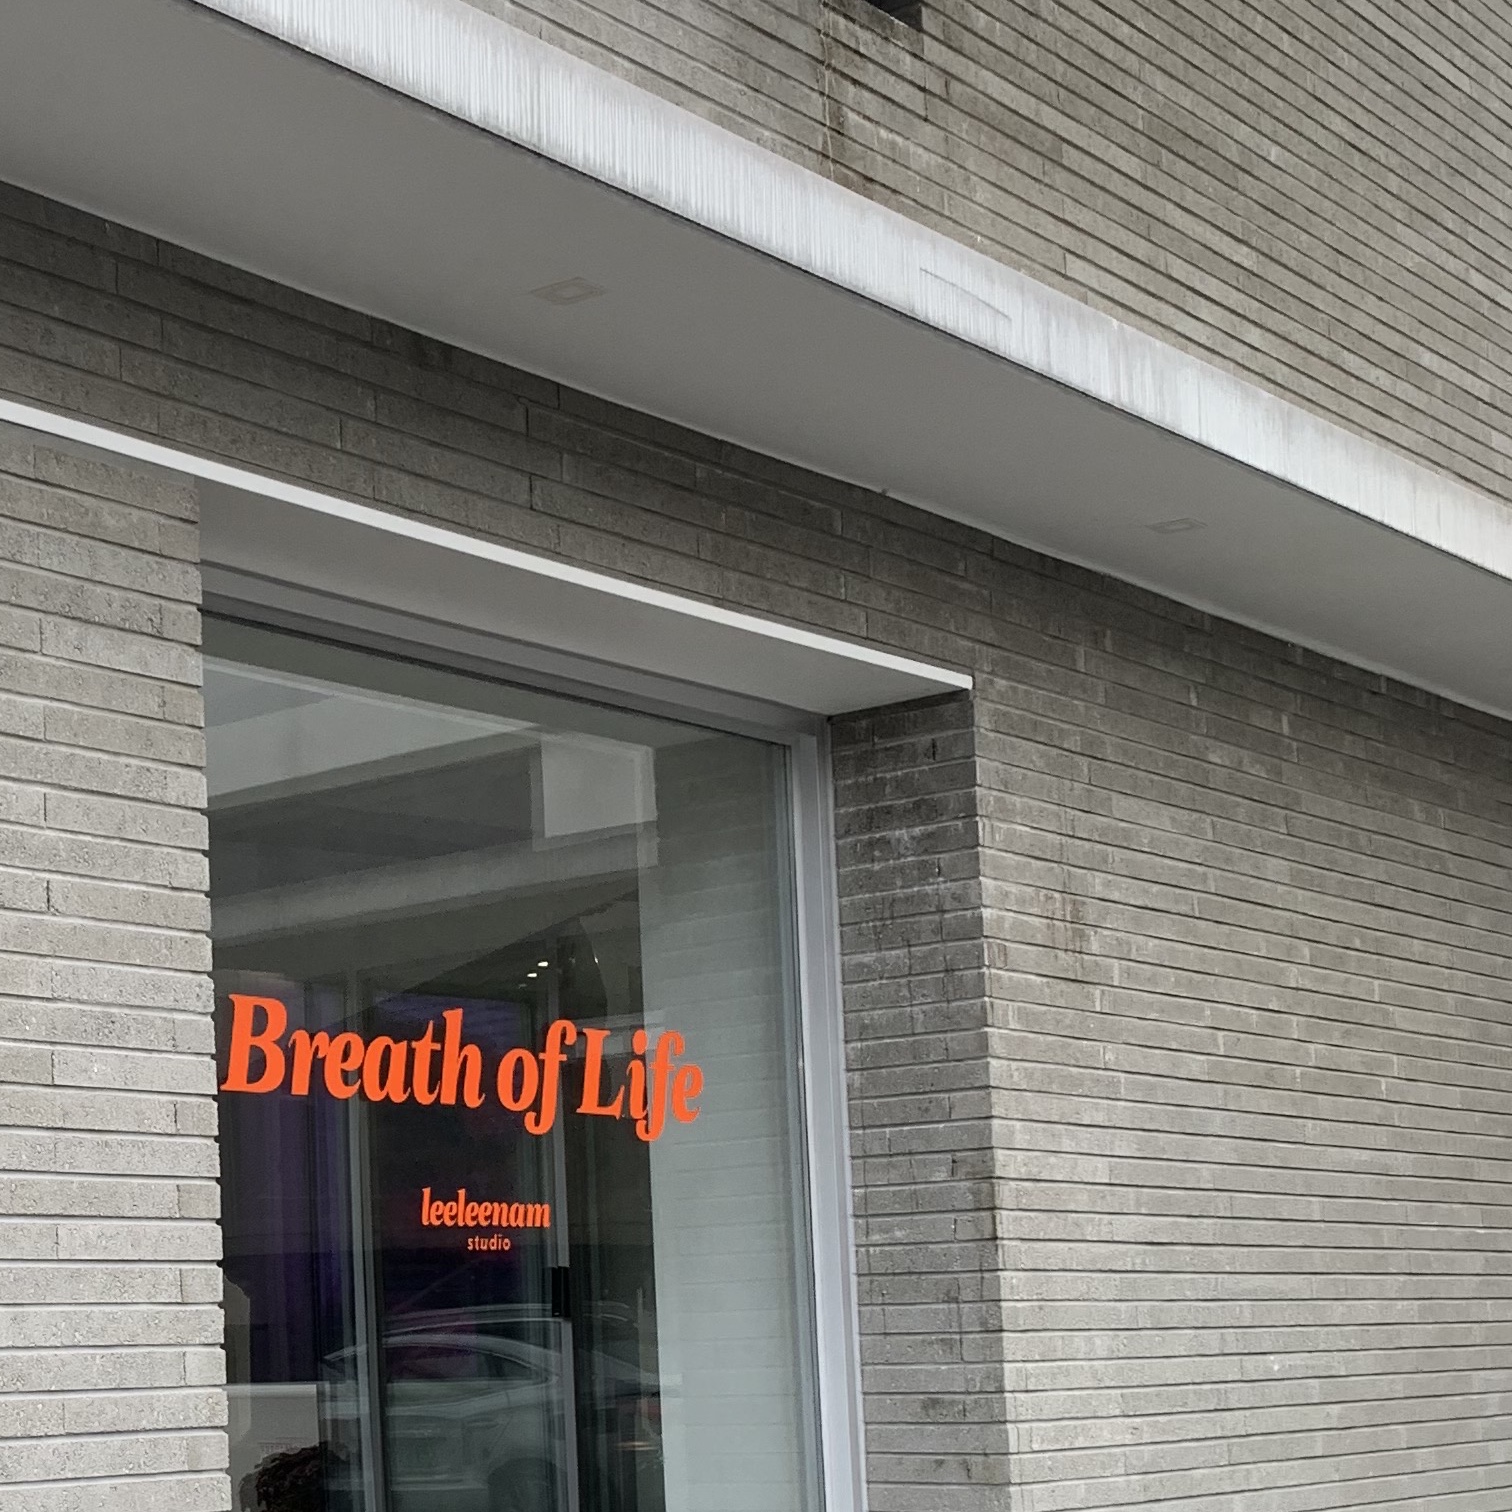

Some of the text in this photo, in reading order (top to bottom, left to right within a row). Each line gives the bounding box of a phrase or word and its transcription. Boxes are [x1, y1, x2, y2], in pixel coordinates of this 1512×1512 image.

[221, 994, 705, 1142] Breath of Life
[422, 1187, 551, 1228] leeleenam
[467, 1234, 511, 1250] studio
